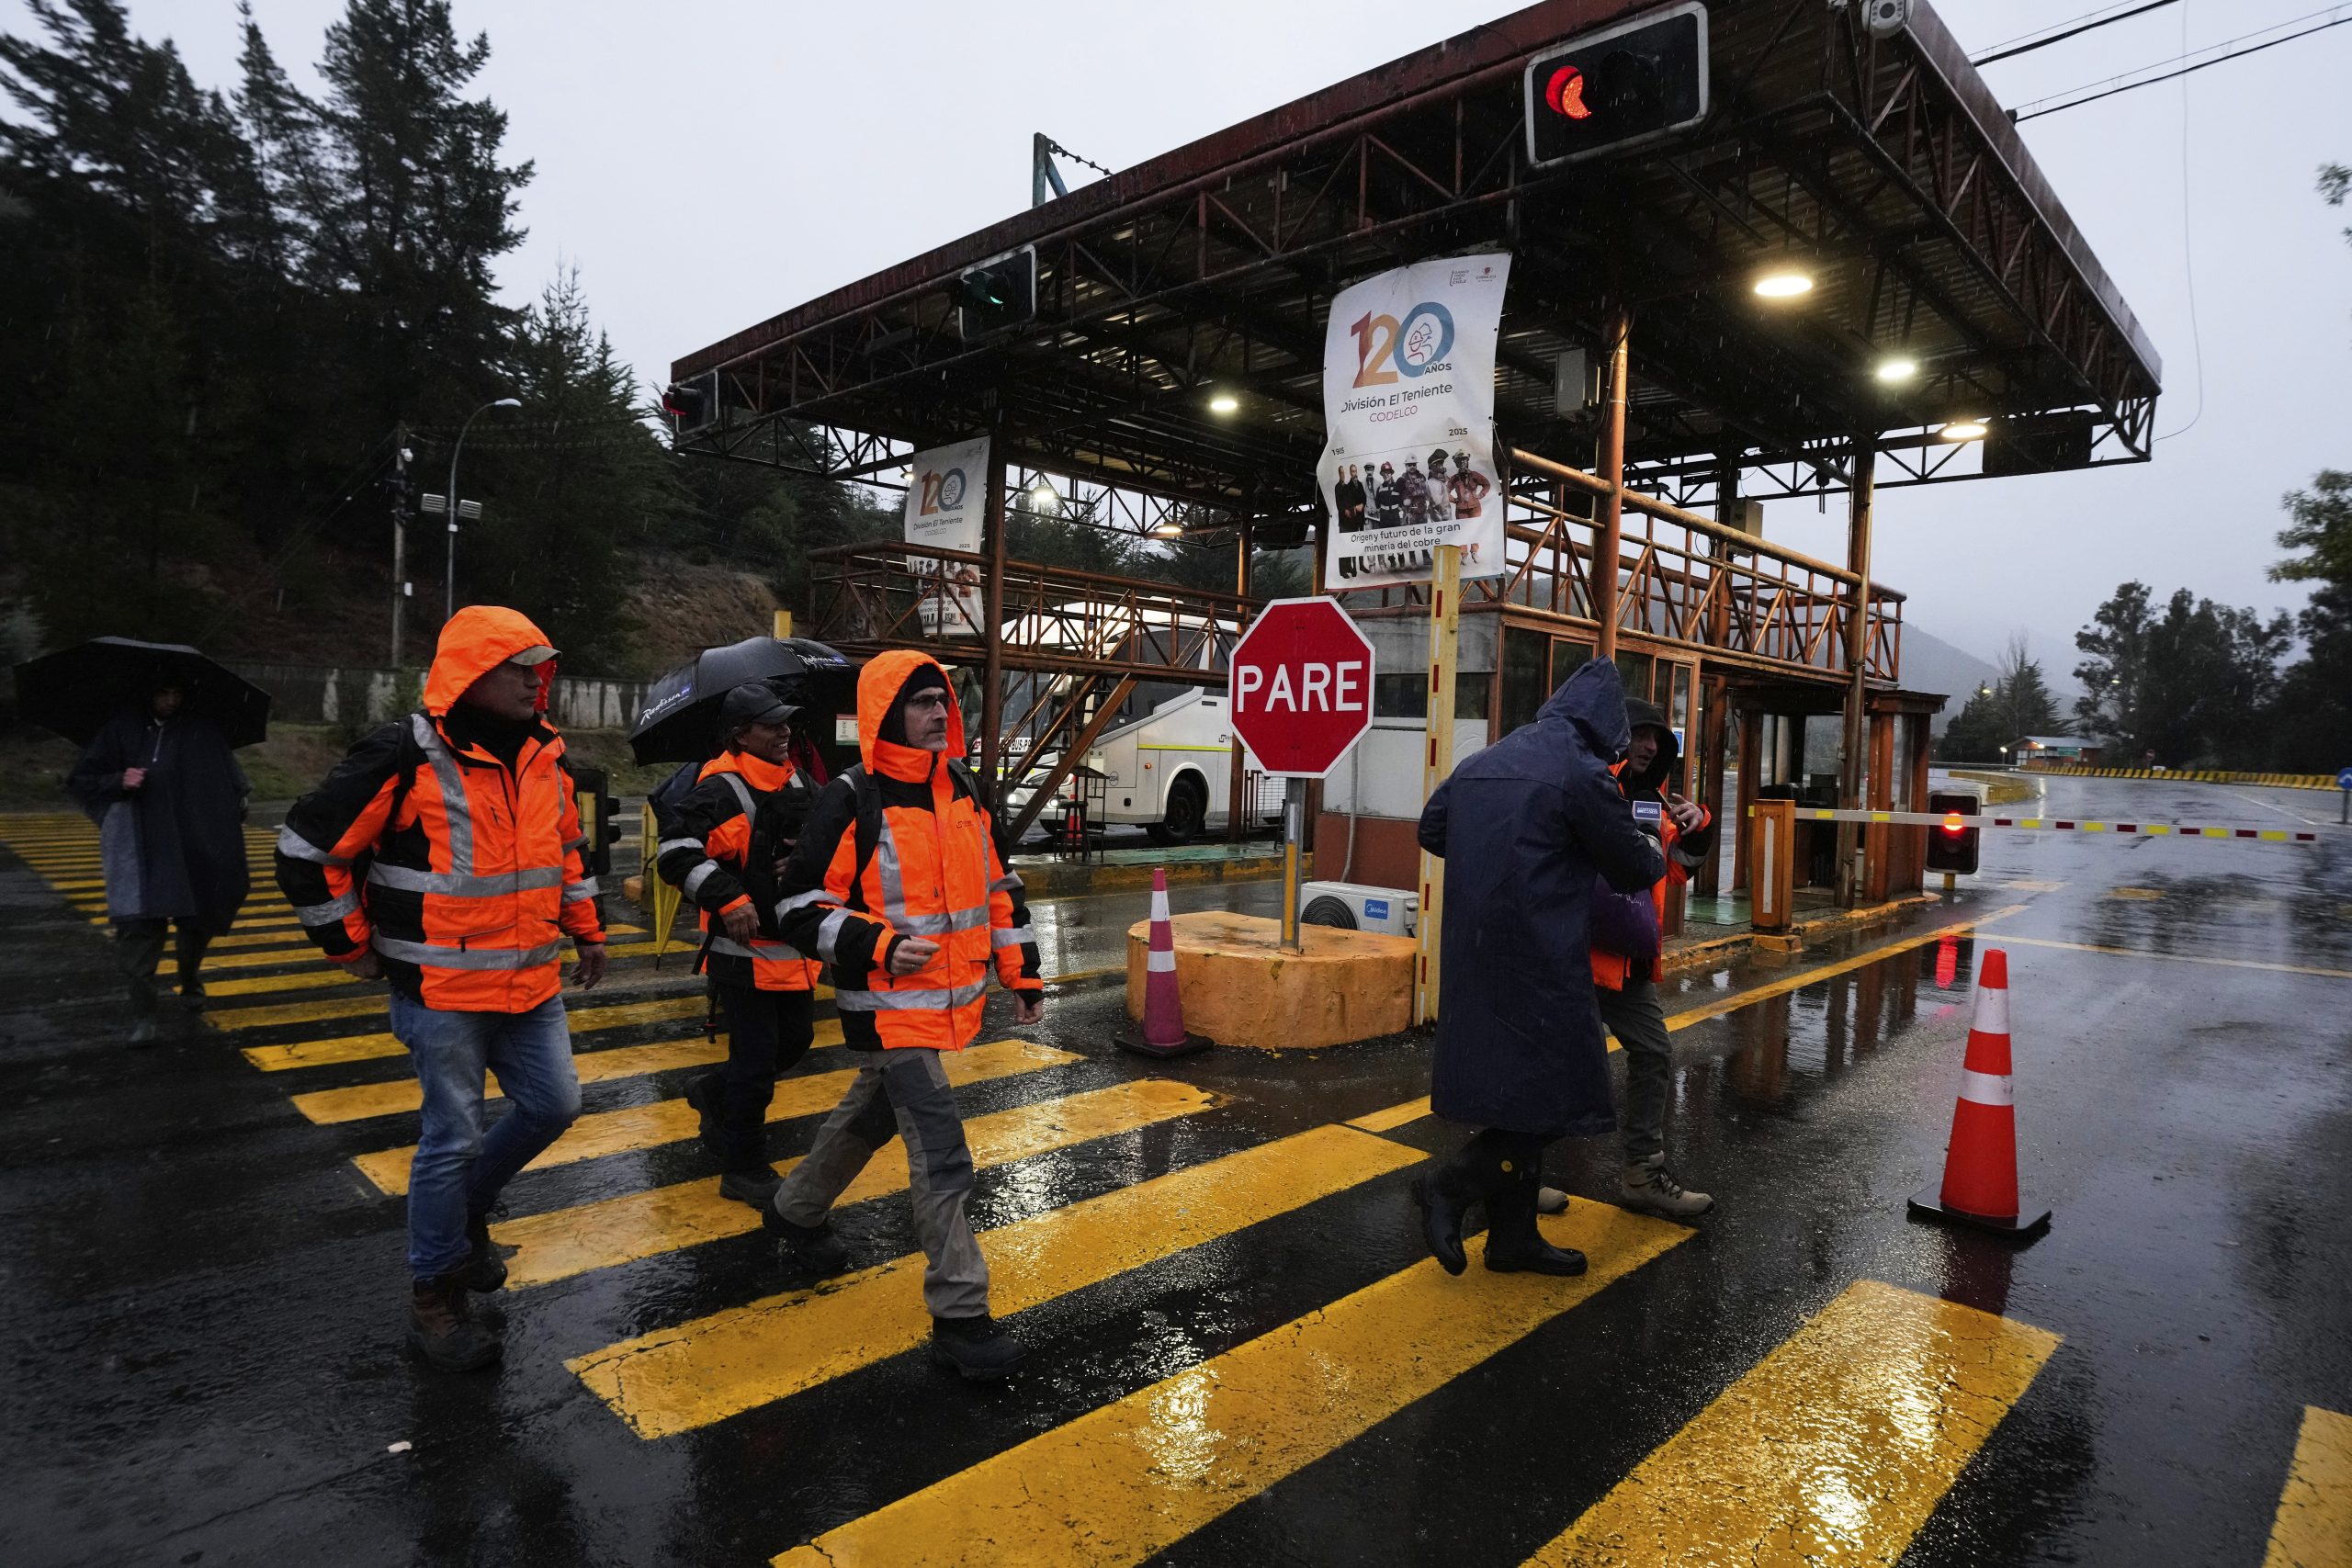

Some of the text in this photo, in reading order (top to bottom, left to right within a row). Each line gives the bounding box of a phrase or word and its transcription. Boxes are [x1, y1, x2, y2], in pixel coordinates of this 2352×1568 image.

[1351, 302, 1454, 389] 120
[1424, 362, 1452, 375] AÑOS
[1389, 393, 1399, 406] El
[1402, 383, 1453, 402] Teniente
[1369, 405, 1419, 423] CODELCO
[1449, 428, 1468, 436] 2025
[1351, 524, 1461, 544] Origen y futuro de la gran
[1397, 539, 1411, 548] del
[1413, 538, 1441, 547] cobre
[1237, 660, 1363, 713] PARE
